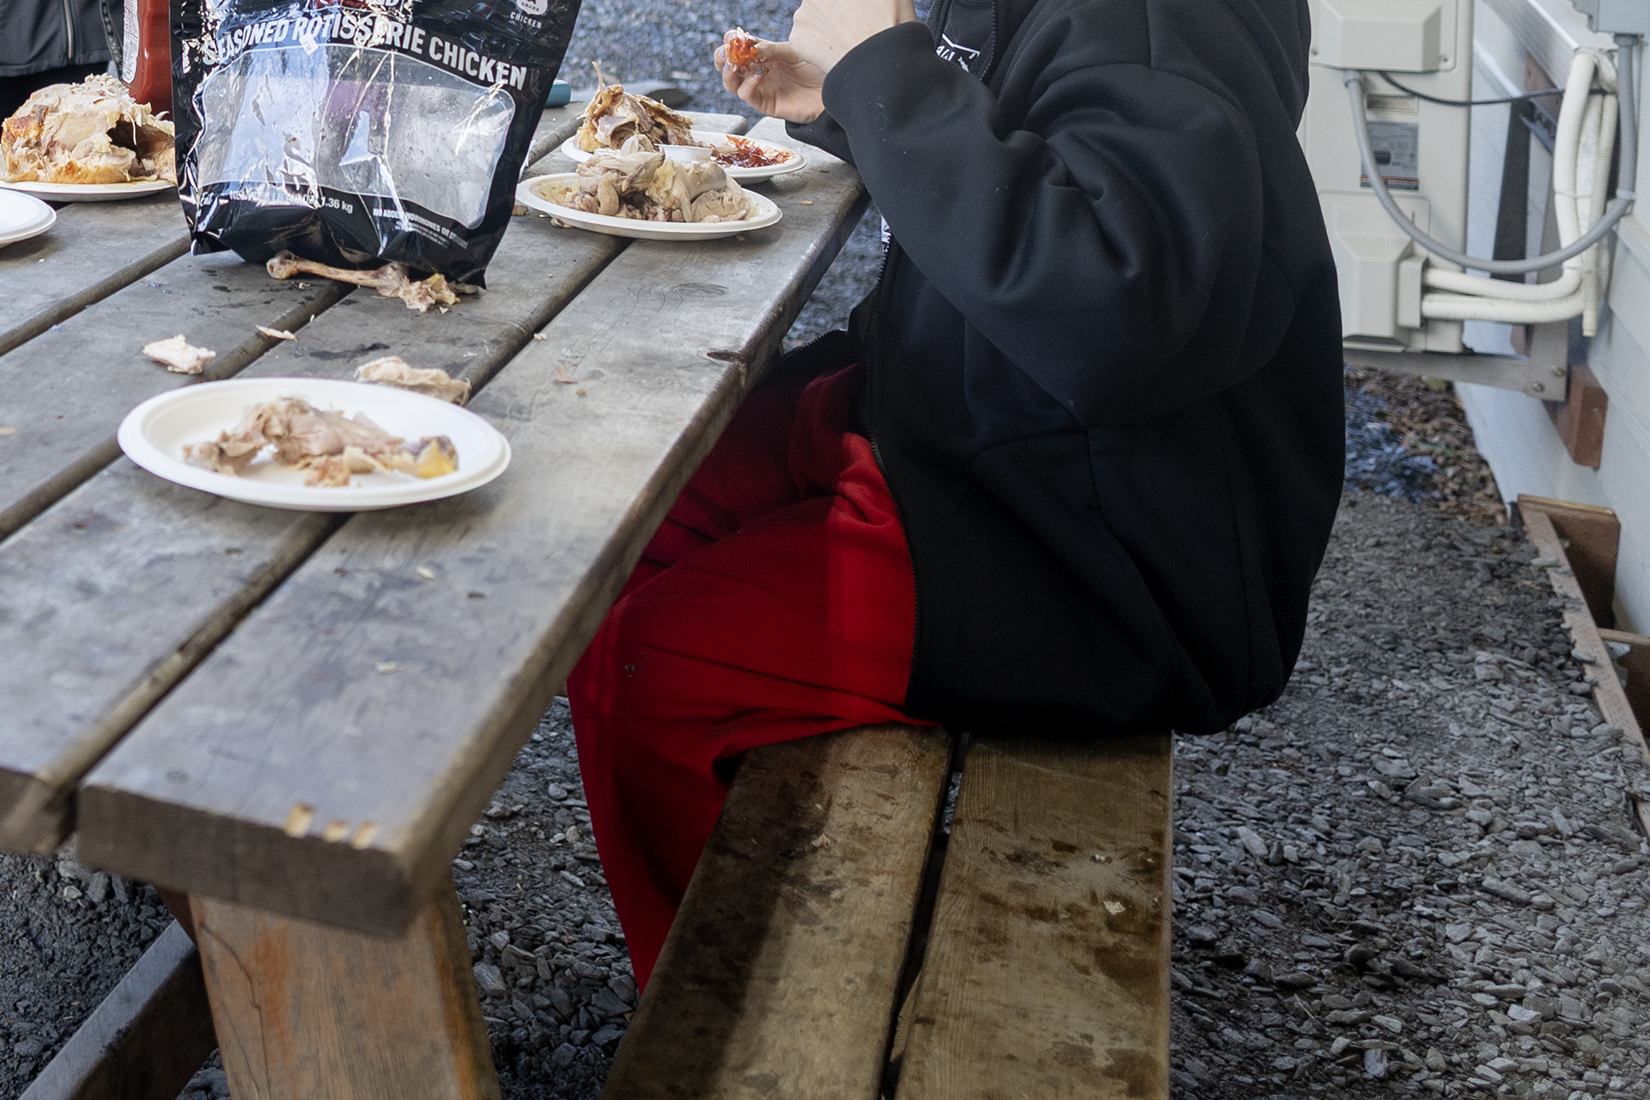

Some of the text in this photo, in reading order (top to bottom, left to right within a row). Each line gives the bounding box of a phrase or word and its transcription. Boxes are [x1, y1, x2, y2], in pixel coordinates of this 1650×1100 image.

[510, 11, 543, 29] CHICKEN
[202, 12, 527, 91] SEASONED ROTISSRIE CHICKEN
[321, 196, 340, 209] 1.36
[341, 200, 354, 214] kg
[372, 208, 383, 217] NO
[383, 209, 403, 220] ADDE
